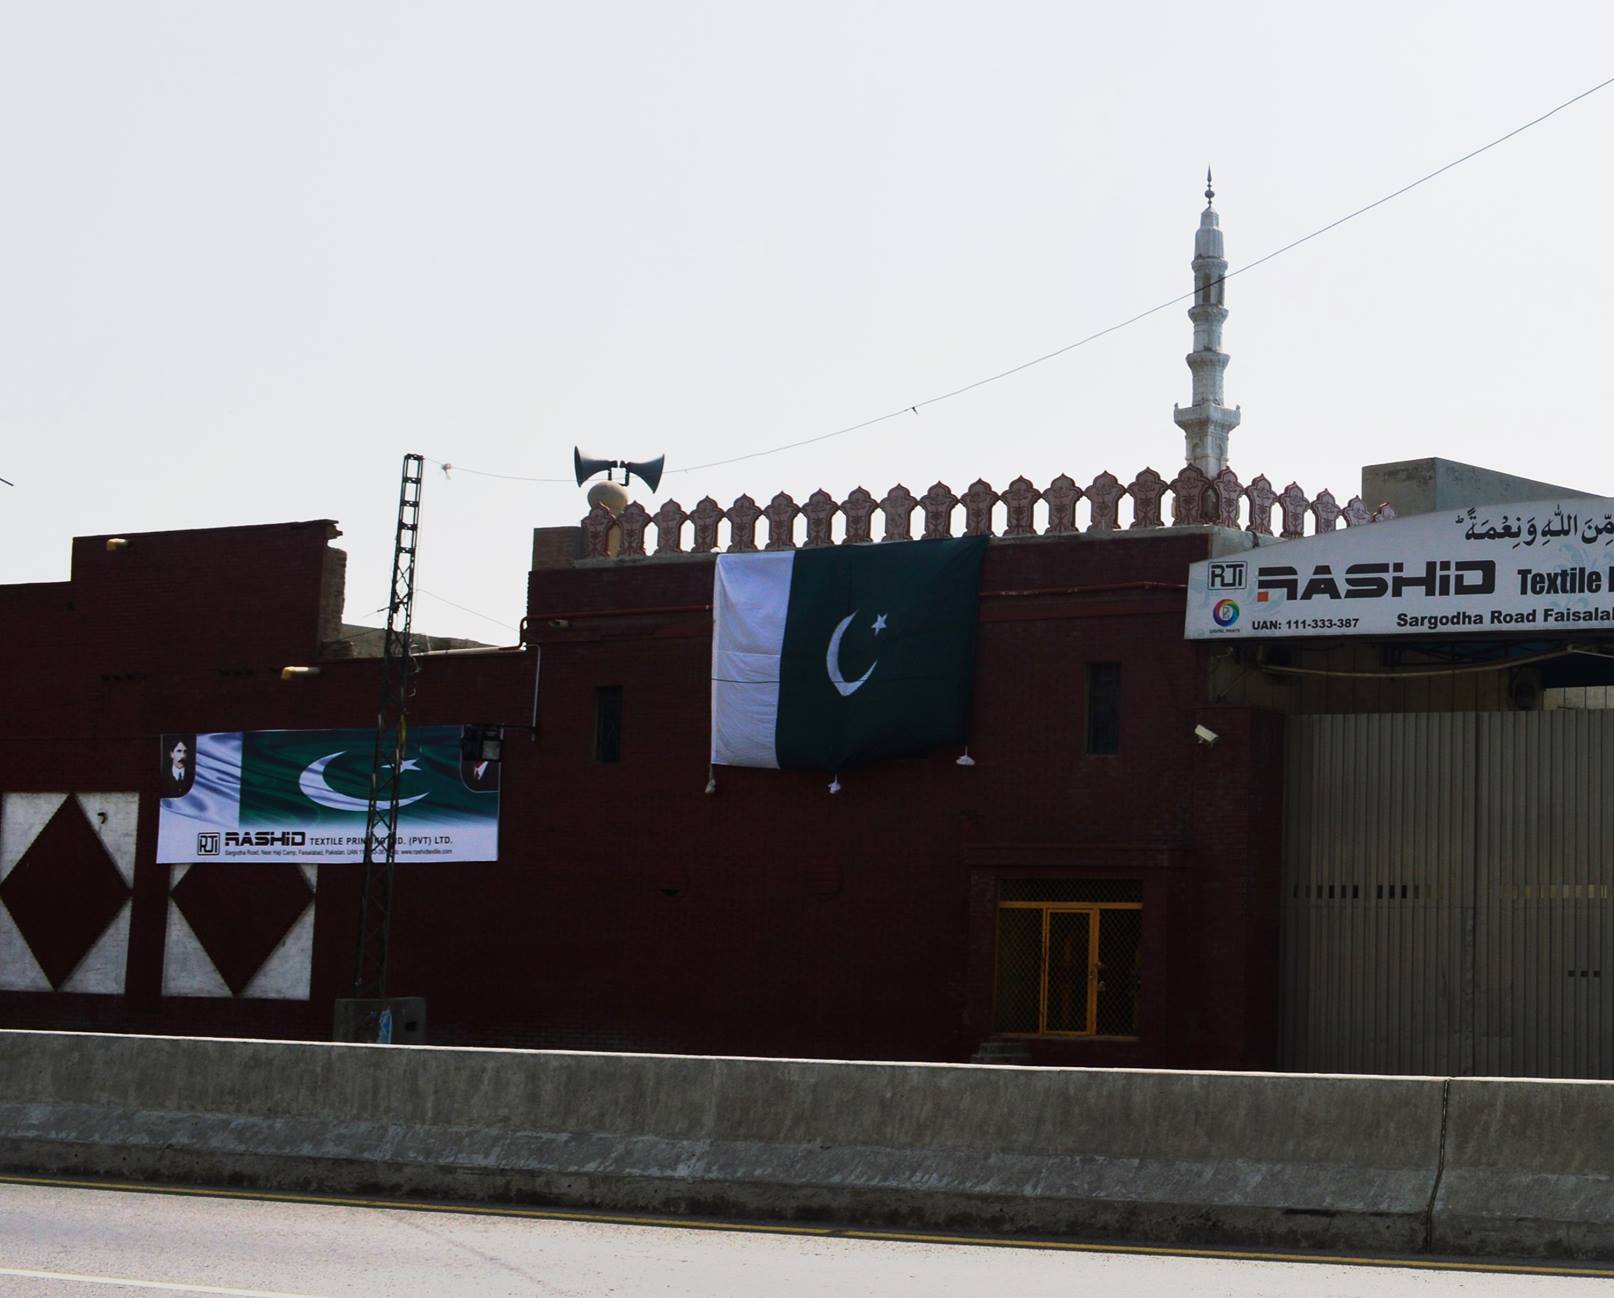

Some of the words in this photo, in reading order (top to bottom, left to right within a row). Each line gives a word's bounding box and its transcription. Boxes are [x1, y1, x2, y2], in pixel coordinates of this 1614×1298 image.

[1518, 567, 1601, 595] Textile
[1252, 621, 1281, 630] UAN:
[1286, 618, 1359, 629] 111-333-387
[1396, 611, 1484, 630] Sargodha
[1491, 609, 1536, 624] Road
[309, 837, 344, 846] TEXTILE
[408, 836, 432, 846] (PVT)
[434, 836, 454, 845] LTD.
